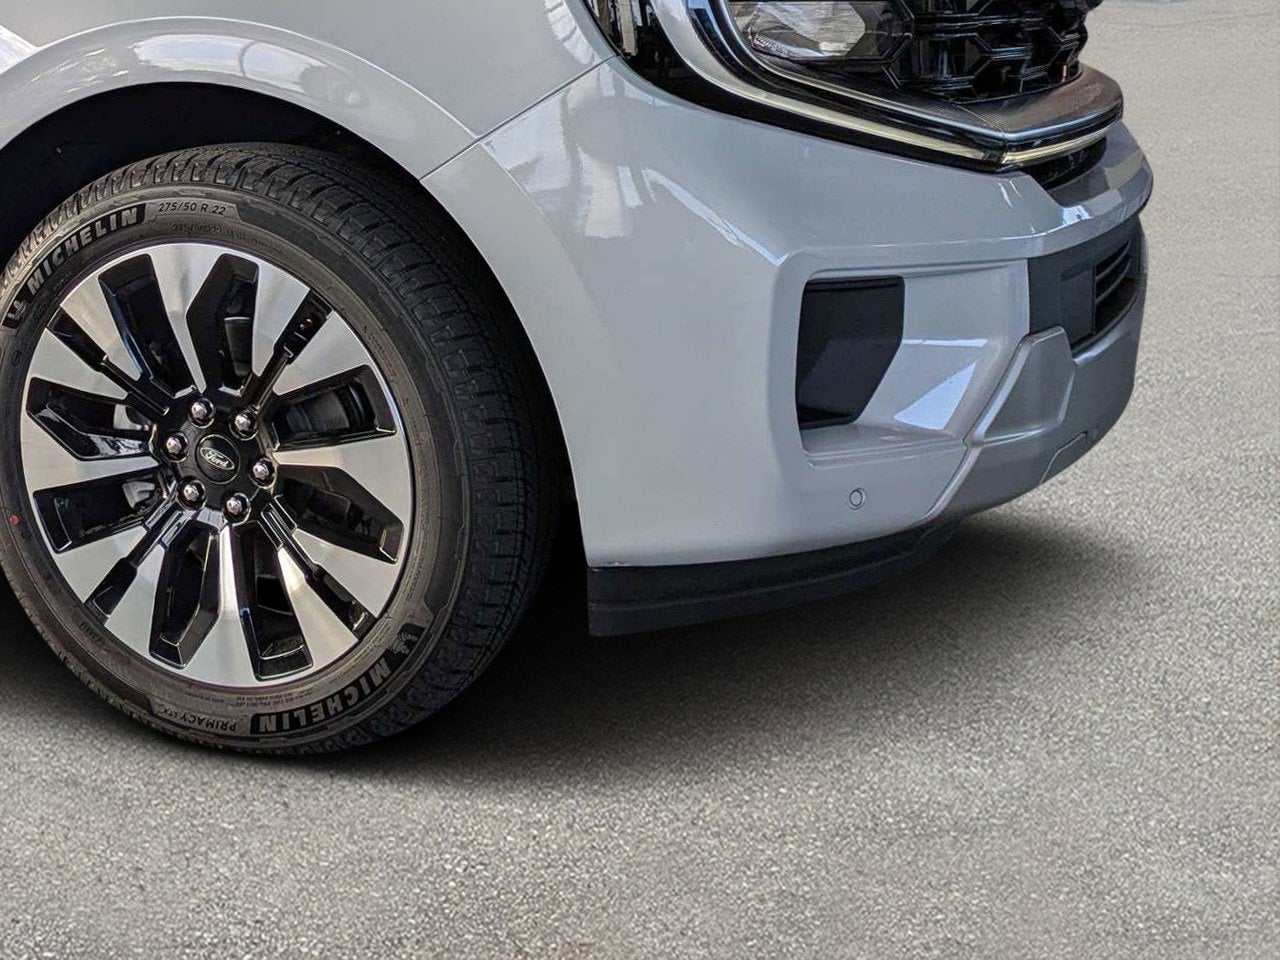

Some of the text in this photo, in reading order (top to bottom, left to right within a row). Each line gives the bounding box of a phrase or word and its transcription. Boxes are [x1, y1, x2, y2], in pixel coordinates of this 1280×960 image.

[158, 201, 226, 215] 275/50 R 22
[26, 206, 138, 296] MICHELIN
[206, 450, 229, 468] Ford
[259, 657, 392, 732] MICHELIN
[180, 714, 237, 732] PRIMACY
